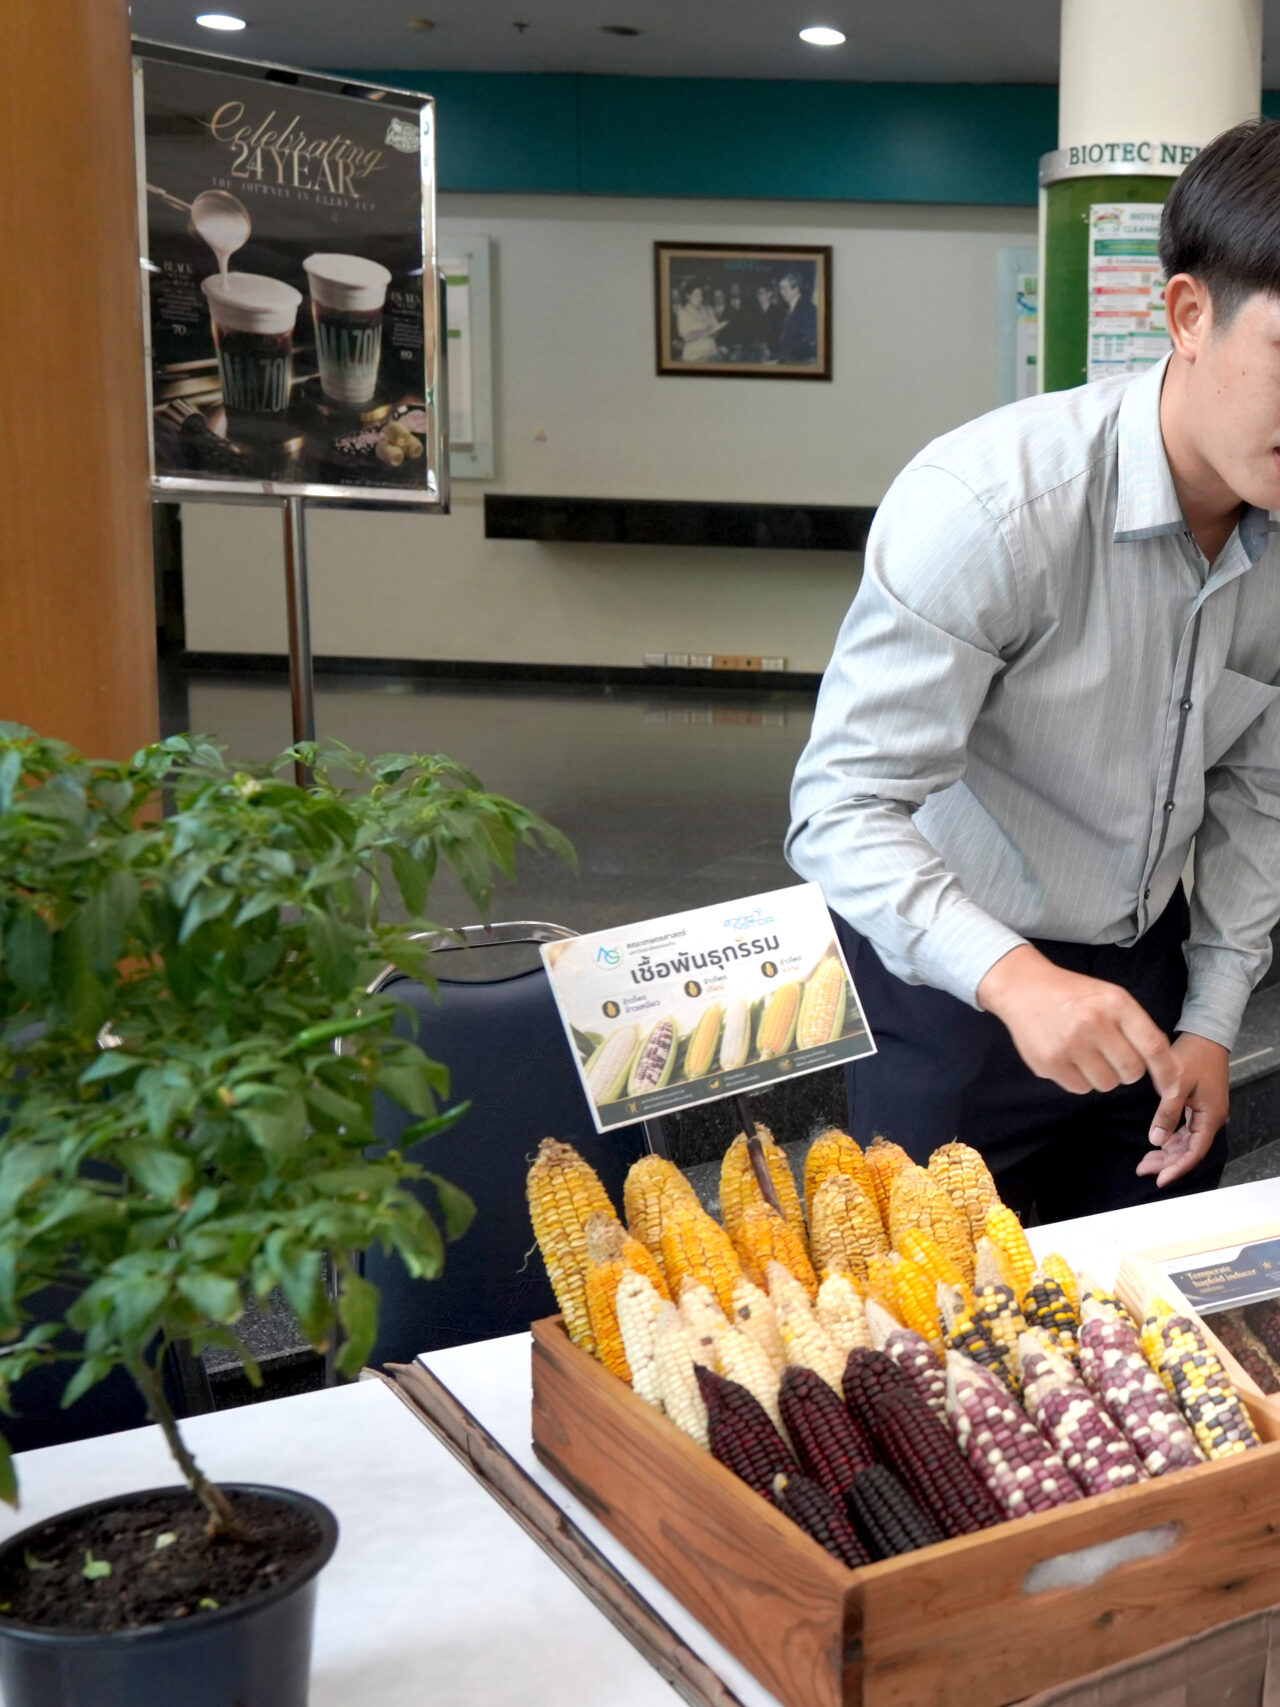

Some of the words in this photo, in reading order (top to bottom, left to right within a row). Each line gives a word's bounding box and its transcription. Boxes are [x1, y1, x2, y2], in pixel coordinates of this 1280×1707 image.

[209, 101, 388, 178] Celebrating
[1069, 142, 1150, 166] BIOTEC
[270, 147, 361, 198] YEAR
[631, 935, 780, 984] เชื้อพันธุกรรม
[1186, 1265, 1232, 1281] Temperate
[1226, 1268, 1257, 1281] inducer
